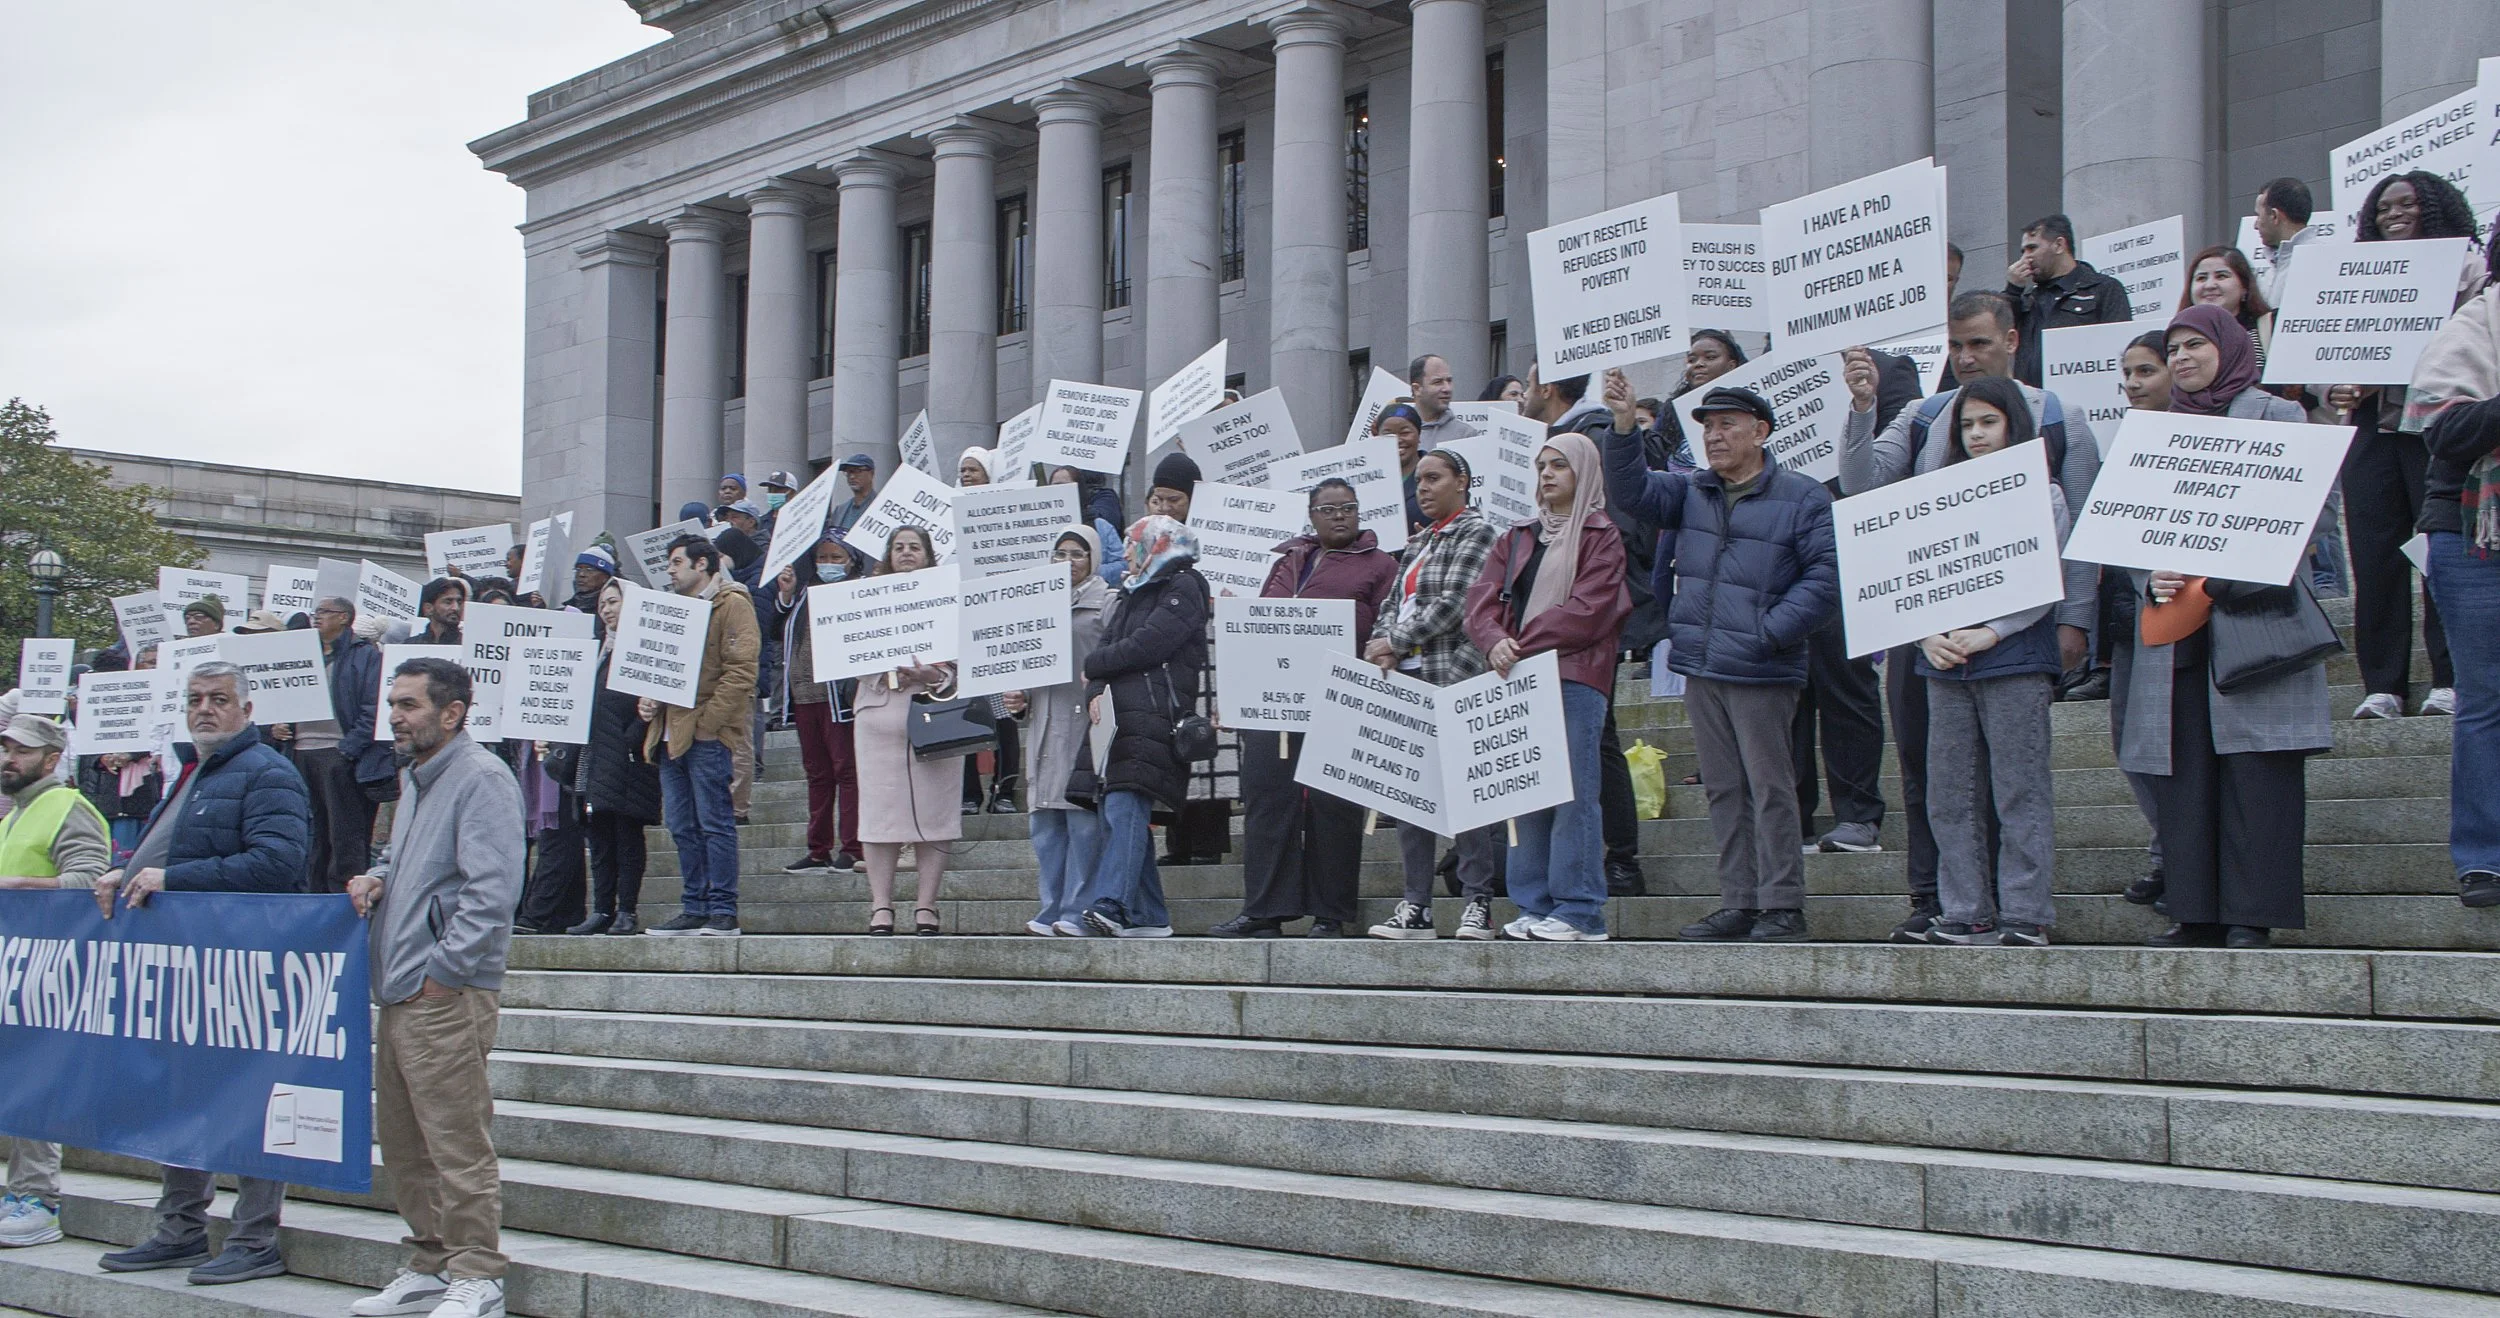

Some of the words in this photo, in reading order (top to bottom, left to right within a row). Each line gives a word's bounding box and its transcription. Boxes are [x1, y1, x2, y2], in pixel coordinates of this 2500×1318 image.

[1803, 219, 1808, 234] I
[1811, 207, 1848, 232] HAVE
[1850, 203, 1861, 221] A
[1863, 194, 1891, 216] PhD
[1558, 231, 1591, 253] DON'T
[1593, 215, 1648, 244] RESETTLE
[1772, 254, 1798, 276] BUT
[1801, 247, 1822, 268] MY
[1826, 216, 1932, 260] CASEMANAGER
[1563, 247, 1618, 274] REFUGEES
[1620, 239, 1646, 259] INTO
[1692, 241, 1742, 254] ENGLISH
[1744, 243, 1756, 255] IS
[1699, 259, 1715, 271] TO
[2338, 259, 2410, 276] EVALUATE
[1581, 266, 1630, 292] POVERTY
[1698, 276, 1722, 289] FOR
[1724, 278, 1746, 290] ALL
[1804, 268, 1864, 299] OFFERED
[1868, 262, 1890, 281] ME
[1893, 259, 1903, 275] A
[1691, 294, 1752, 308] REFUGEES
[2316, 289, 2360, 305] STATE
[2361, 288, 2419, 304] FUNDED
[1562, 323, 1581, 340] WE
[1582, 316, 1611, 336] NEED
[1613, 305, 1661, 328] ENGLISH
[1787, 304, 1851, 336] MINIMUM
[1853, 293, 1896, 318] WAGE
[1899, 285, 1927, 306] JOB
[2281, 318, 2343, 333] REFUGEE
[2344, 316, 2444, 332] EMPLOYMENT
[1555, 338, 1612, 365] LANGUAGE
[1613, 334, 1629, 351] TO
[1630, 325, 1671, 347] THRIVE
[2315, 346, 2392, 361] OUTCOMES
[2050, 358, 2117, 376] LIVABLE
[1056, 388, 1090, 402] REMOVE
[1090, 393, 1130, 407] BARRIERS
[1062, 403, 1073, 414] TO
[1073, 405, 1096, 417] GOOD
[1096, 409, 1118, 420] JOBS
[1212, 420, 1232, 435] WE
[1231, 412, 1252, 428] PAY
[1046, 429, 1076, 442] ENLIGH
[1075, 433, 1118, 448] LANGUAGE
[1208, 431, 1244, 453] TAXES
[1243, 424, 1271, 440] TOO!
[2168, 433, 2247, 454] POVERTY
[2247, 440, 2285, 457] HAS
[1060, 445, 1097, 459] CLASSES
[2129, 452, 2304, 482] INTERGENERATIONAL
[2173, 480, 2241, 499] IMPACT
[913, 490, 952, 516] DON'T
[967, 505, 1007, 518] ALLOCATE
[1007, 504, 1017, 514] $7
[1019, 500, 1052, 512] MILLION
[1053, 499, 1064, 508] TO
[1853, 510, 1900, 537] HELP
[1905, 501, 1931, 520] US
[1935, 472, 2027, 511] SUCCEED
[859, 515, 890, 538] INTO
[2090, 500, 2168, 521] SUPPORT
[2169, 508, 2193, 525] US
[2196, 511, 2219, 527] TO
[2221, 514, 2305, 536] SUPPORT
[1908, 536, 1960, 564] INVEST
[1964, 530, 1980, 548] IN
[2141, 528, 2177, 546] OUR
[2178, 533, 2228, 552] KIDS!
[1858, 575, 1903, 602] ADULT
[1906, 567, 1935, 587] ESL
[1937, 536, 2039, 578] INSTRUCTION
[371, 574, 384, 587] IT'S
[383, 579, 399, 594] TIME
[399, 586, 408, 598] TO
[851, 591, 855, 600] I
[857, 585, 890, 598] CAN'T
[892, 580, 919, 592] HELP
[964, 589, 998, 607] DON'T
[1000, 580, 1046, 600] FORGET
[1049, 577, 1065, 591] US
[1895, 592, 1924, 613] FOR
[1927, 570, 2004, 604] REFUGEES
[641, 600, 656, 612] PUT
[655, 603, 690, 619] YOURSELF
[817, 615, 834, 626] MY
[836, 610, 862, 623] KIDS
[863, 605, 892, 618] WITH
[894, 595, 958, 614] HOMEWORK
[1248, 604, 1273, 617] ONLY
[1274, 605, 1303, 618] 68.8%
[1305, 606, 1318, 618] OF
[639, 616, 647, 627] IN
[647, 618, 662, 630] OUR
[662, 621, 685, 635] SHOES
[843, 626, 893, 643] BECAUSE
[895, 626, 899, 635] I
[901, 620, 934, 634] DON'T
[972, 625, 1004, 641] WHERE
[1005, 623, 1015, 636] IS
[1016, 619, 1034, 634] THE
[1036, 616, 1056, 631] BILL
[1226, 621, 1242, 633] ELL
[1243, 622, 1291, 635] STUDENTS
[1293, 623, 1344, 636] GRADUATE
[639, 638, 664, 652] WOULD
[664, 643, 679, 656] YOU
[848, 649, 885, 663] SPEAK
[886, 641, 933, 657] ENGLISH
[986, 644, 998, 657] TO
[999, 637, 1042, 655] ADDRESS
[625, 651, 655, 667] SURVIVE
[654, 657, 686, 673] WITHOUT
[971, 659, 1020, 678] REFUGEES'
[1022, 653, 1057, 670] NEEDS?
[1277, 657, 1290, 669] VS
[262, 677, 281, 689] WE
[282, 674, 319, 688] VOTE!
[619, 665, 653, 683] SPEAKING
[652, 673, 686, 689] ENGLISH?
[1331, 665, 1420, 705] HOMELESSNESS
[1262, 691, 1291, 703] 84.5%
[1293, 692, 1306, 704] OF
[1325, 688, 1339, 702] IN
[1340, 693, 1364, 711] OUR
[1454, 692, 1483, 714] GIVE
[1485, 685, 1503, 704] US
[1505, 674, 1538, 697] TIME
[1240, 707, 1279, 720] NON-ELL
[1466, 715, 1484, 733] TO
[1487, 701, 1529, 727] LEARN
[1358, 724, 1408, 752] INCLUDE
[1408, 742, 1425, 758] US
[1473, 725, 1528, 756] ENGLISH
[1351, 747, 1365, 762] IN
[1365, 752, 1404, 776] PLANS
[1405, 766, 1420, 782] TO
[1467, 761, 1493, 782] AND
[1495, 751, 1521, 772] SEE
[1522, 745, 1542, 764] US
[1322, 763, 1346, 780] END
[1347, 771, 1437, 814] HOMELESSNESS
[1473, 770, 1540, 803] FLOURISH!
[22, 938, 80, 1031] WHO
[74, 940, 120, 1036] ARE
[123, 942, 169, 1040] YET
[169, 945, 199, 1046] TO
[203, 947, 283, 1052] HAVE
[283, 951, 347, 1060] ONE.
